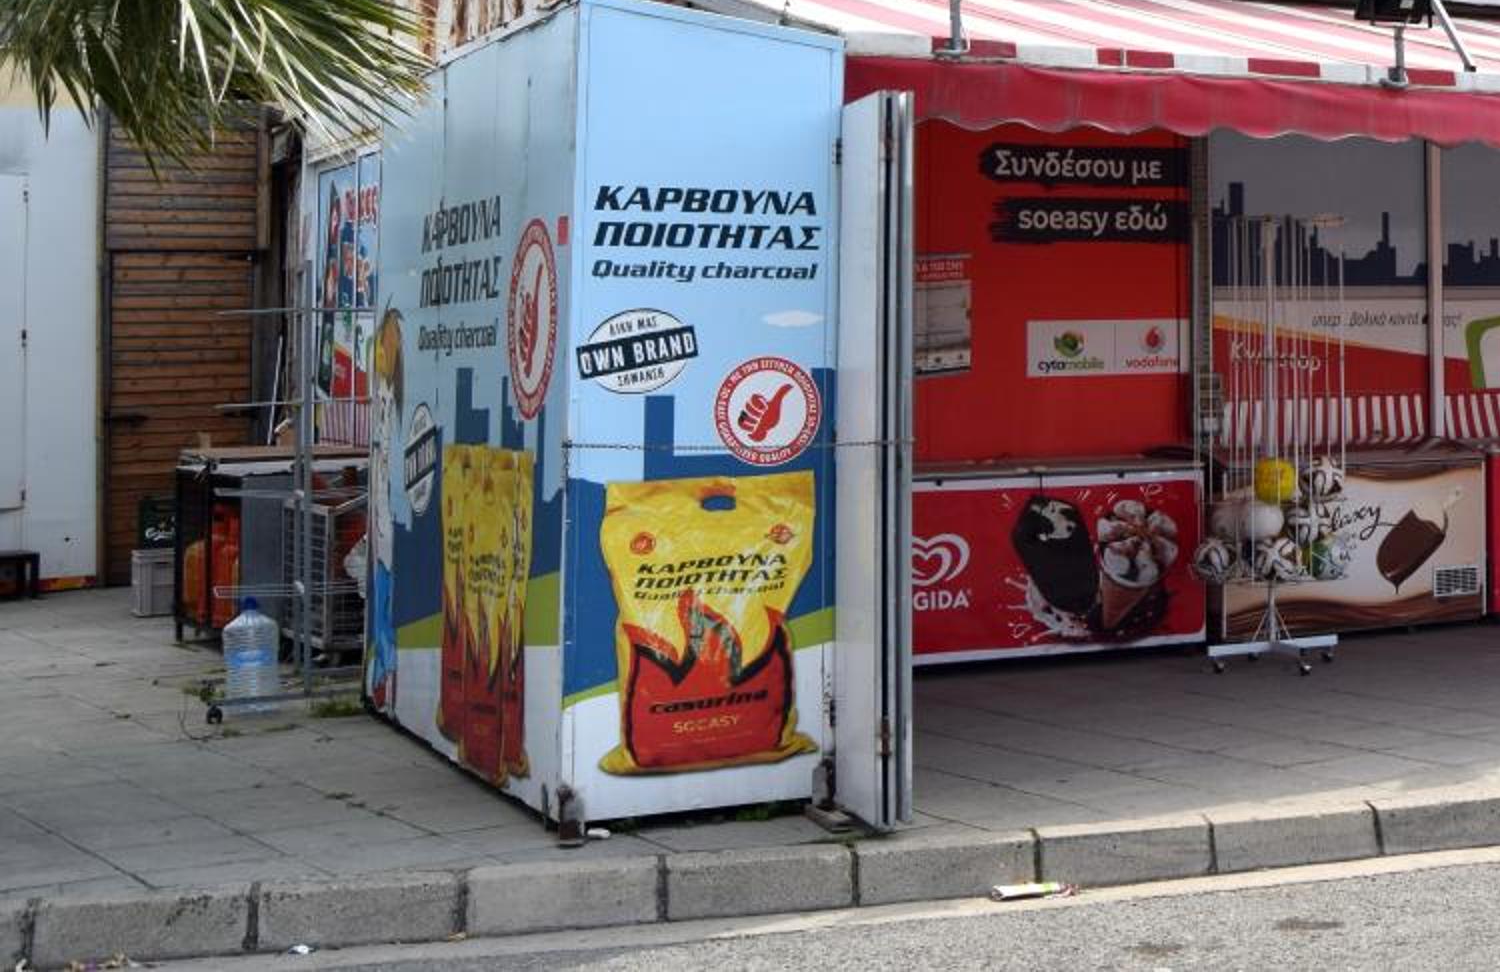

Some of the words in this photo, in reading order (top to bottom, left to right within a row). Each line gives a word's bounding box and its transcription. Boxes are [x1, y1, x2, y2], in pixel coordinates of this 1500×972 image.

[995, 149, 1124, 180] Συνδέσου
[1132, 159, 1162, 184] με
[594, 185, 817, 216] ΚΑΡΒΟΥΝΑ
[1019, 209, 1109, 236] soeasy
[1115, 203, 1168, 231] εδώ
[593, 221, 822, 251] ΠΟΙΟΤΗΤΑΣ
[592, 259, 696, 283] Quality
[702, 262, 818, 280] charcoal
[579, 347, 627, 375] OWN
[633, 330, 695, 363] BRAND
[634, 568, 788, 589] ΠΟΙΟΤΗΤΑΣ
[637, 553, 788, 575] ΚΑΡΒΟΥΝΑ
[913, 589, 969, 611] GIDA
[649, 688, 769, 716] casurina
